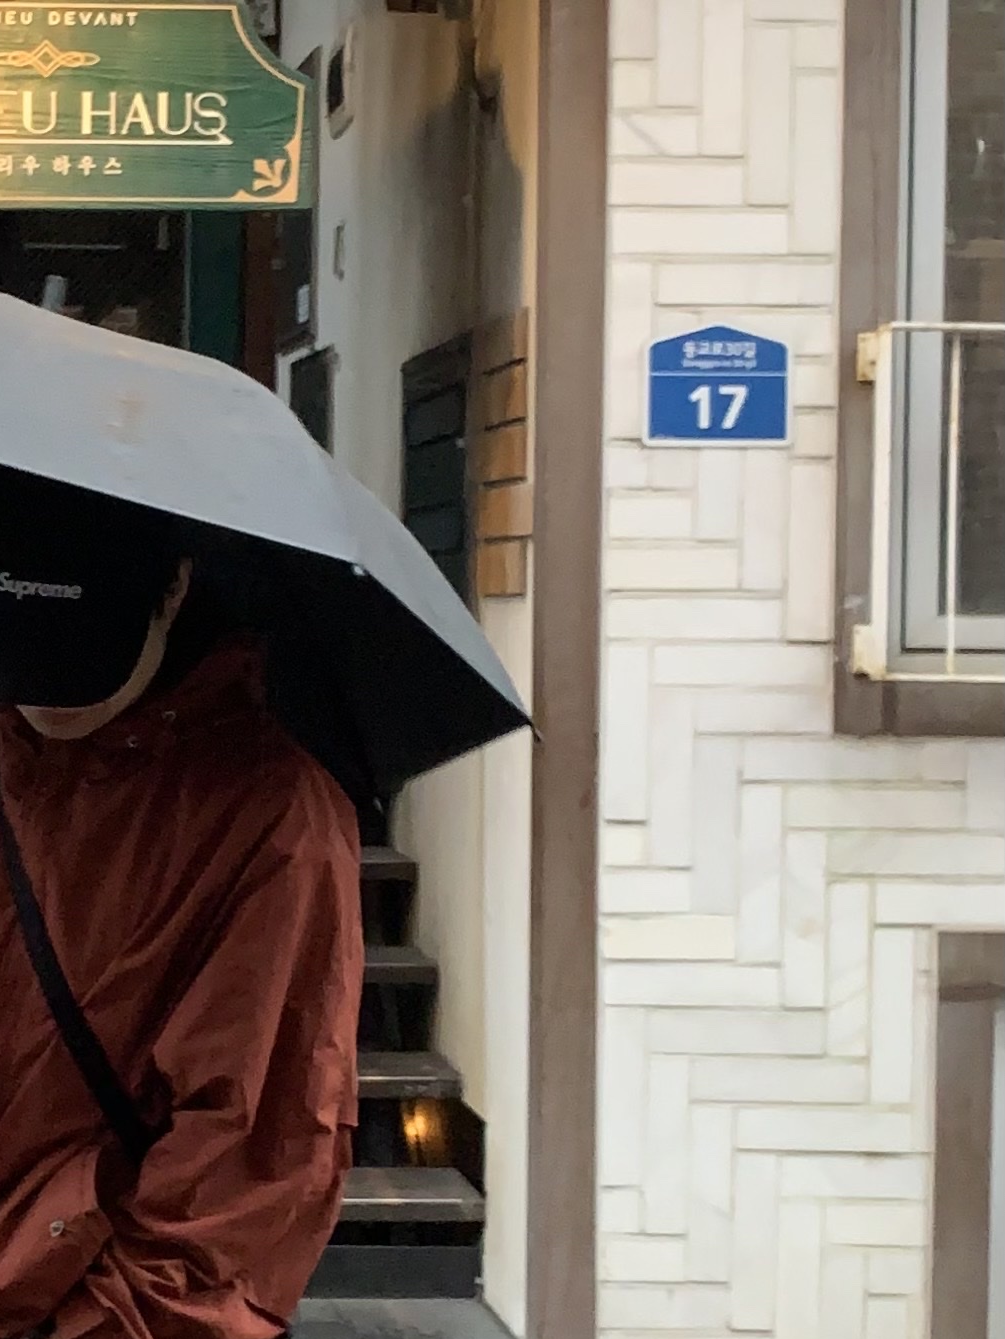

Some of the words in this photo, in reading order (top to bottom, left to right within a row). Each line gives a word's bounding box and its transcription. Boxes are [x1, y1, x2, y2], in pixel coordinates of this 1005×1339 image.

[47, 11, 138, 27] DEVANT
[81, 90, 228, 137] HAUS
[52, 155, 123, 176] 하우스
[688, 384, 749, 429] 17
